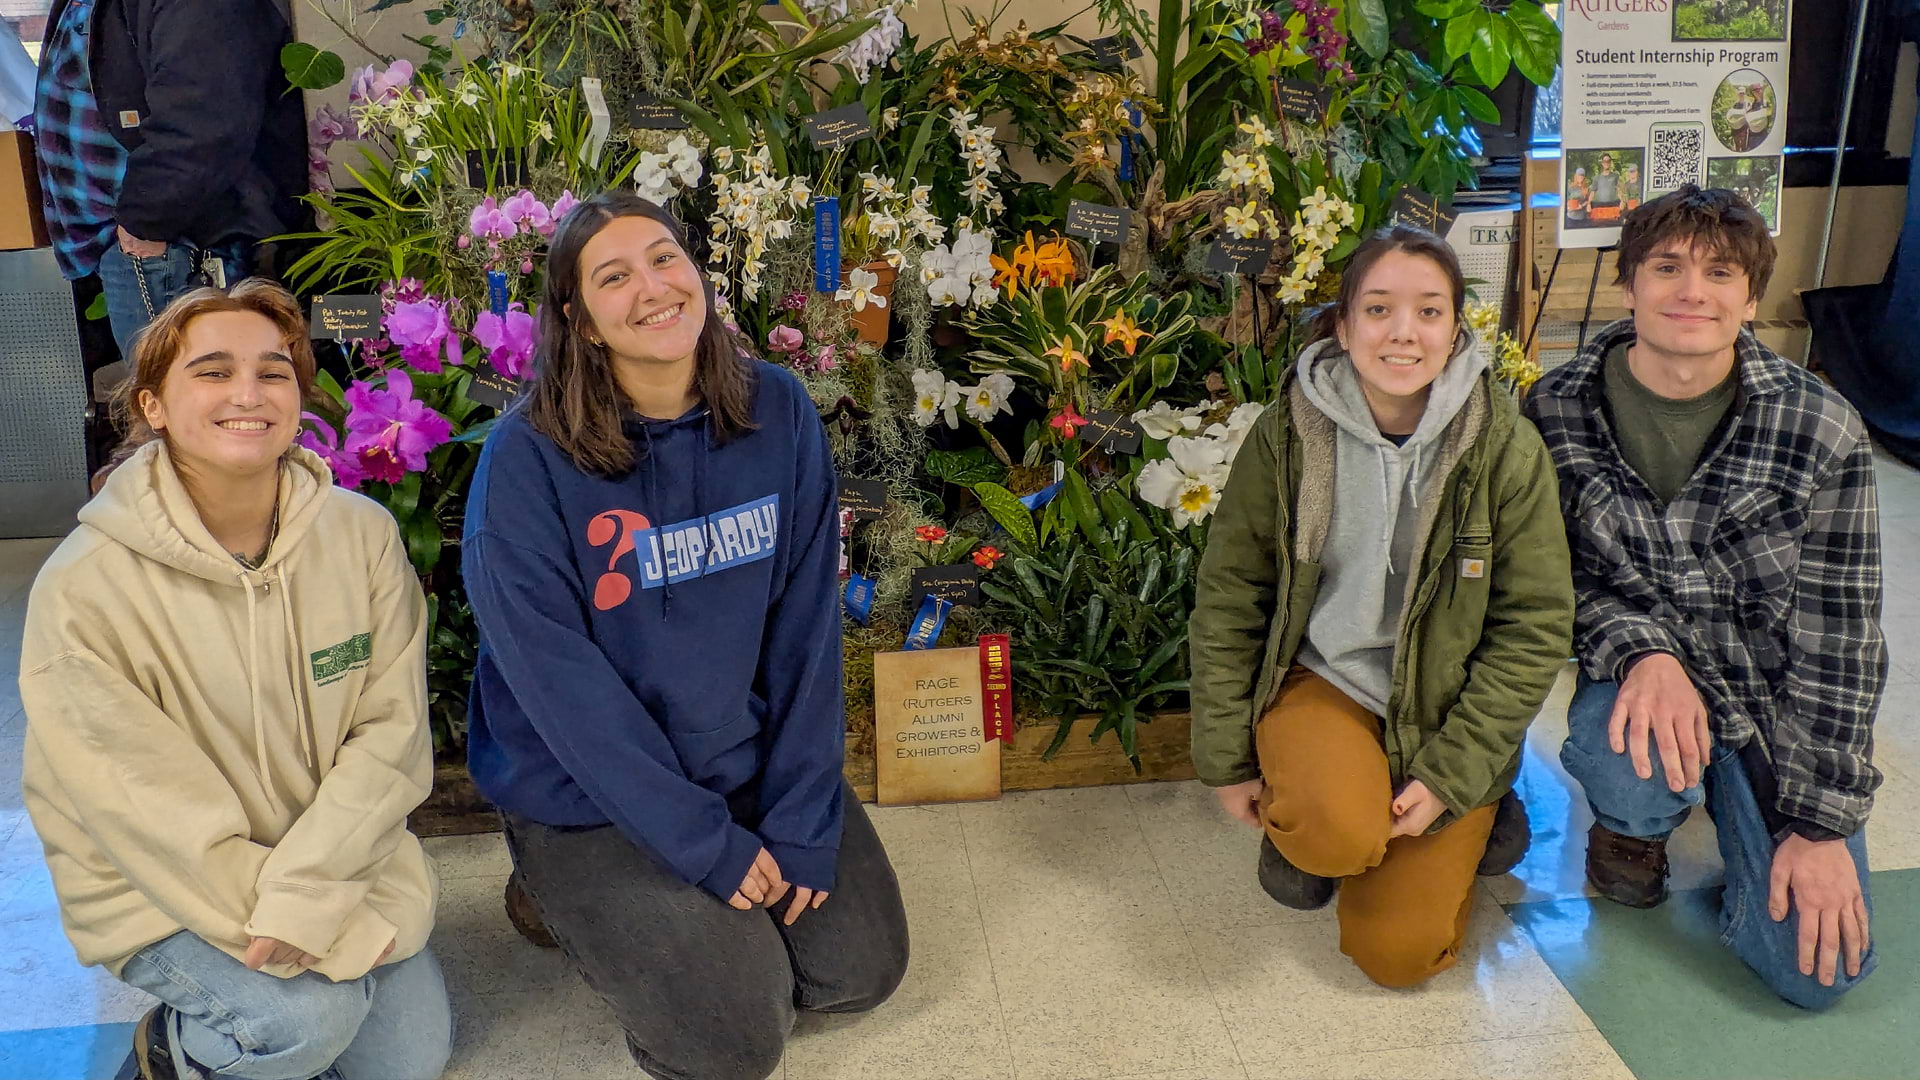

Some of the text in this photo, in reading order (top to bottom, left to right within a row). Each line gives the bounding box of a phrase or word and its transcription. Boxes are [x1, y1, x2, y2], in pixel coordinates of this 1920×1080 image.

[1597, 20, 1629, 30] Gardens
[1576, 48, 1779, 67] Student Internship Program
[645, 502, 778, 580] JEOPARDY!
[915, 677, 960, 691] RAGE
[903, 696, 973, 711] (RUTGERS
[912, 712, 964, 725] ALUMNI
[993, 693, 1002, 736] PLACE
[896, 726, 981, 743] GROWERS &
[896, 742, 981, 759] EXHIBITORS)
